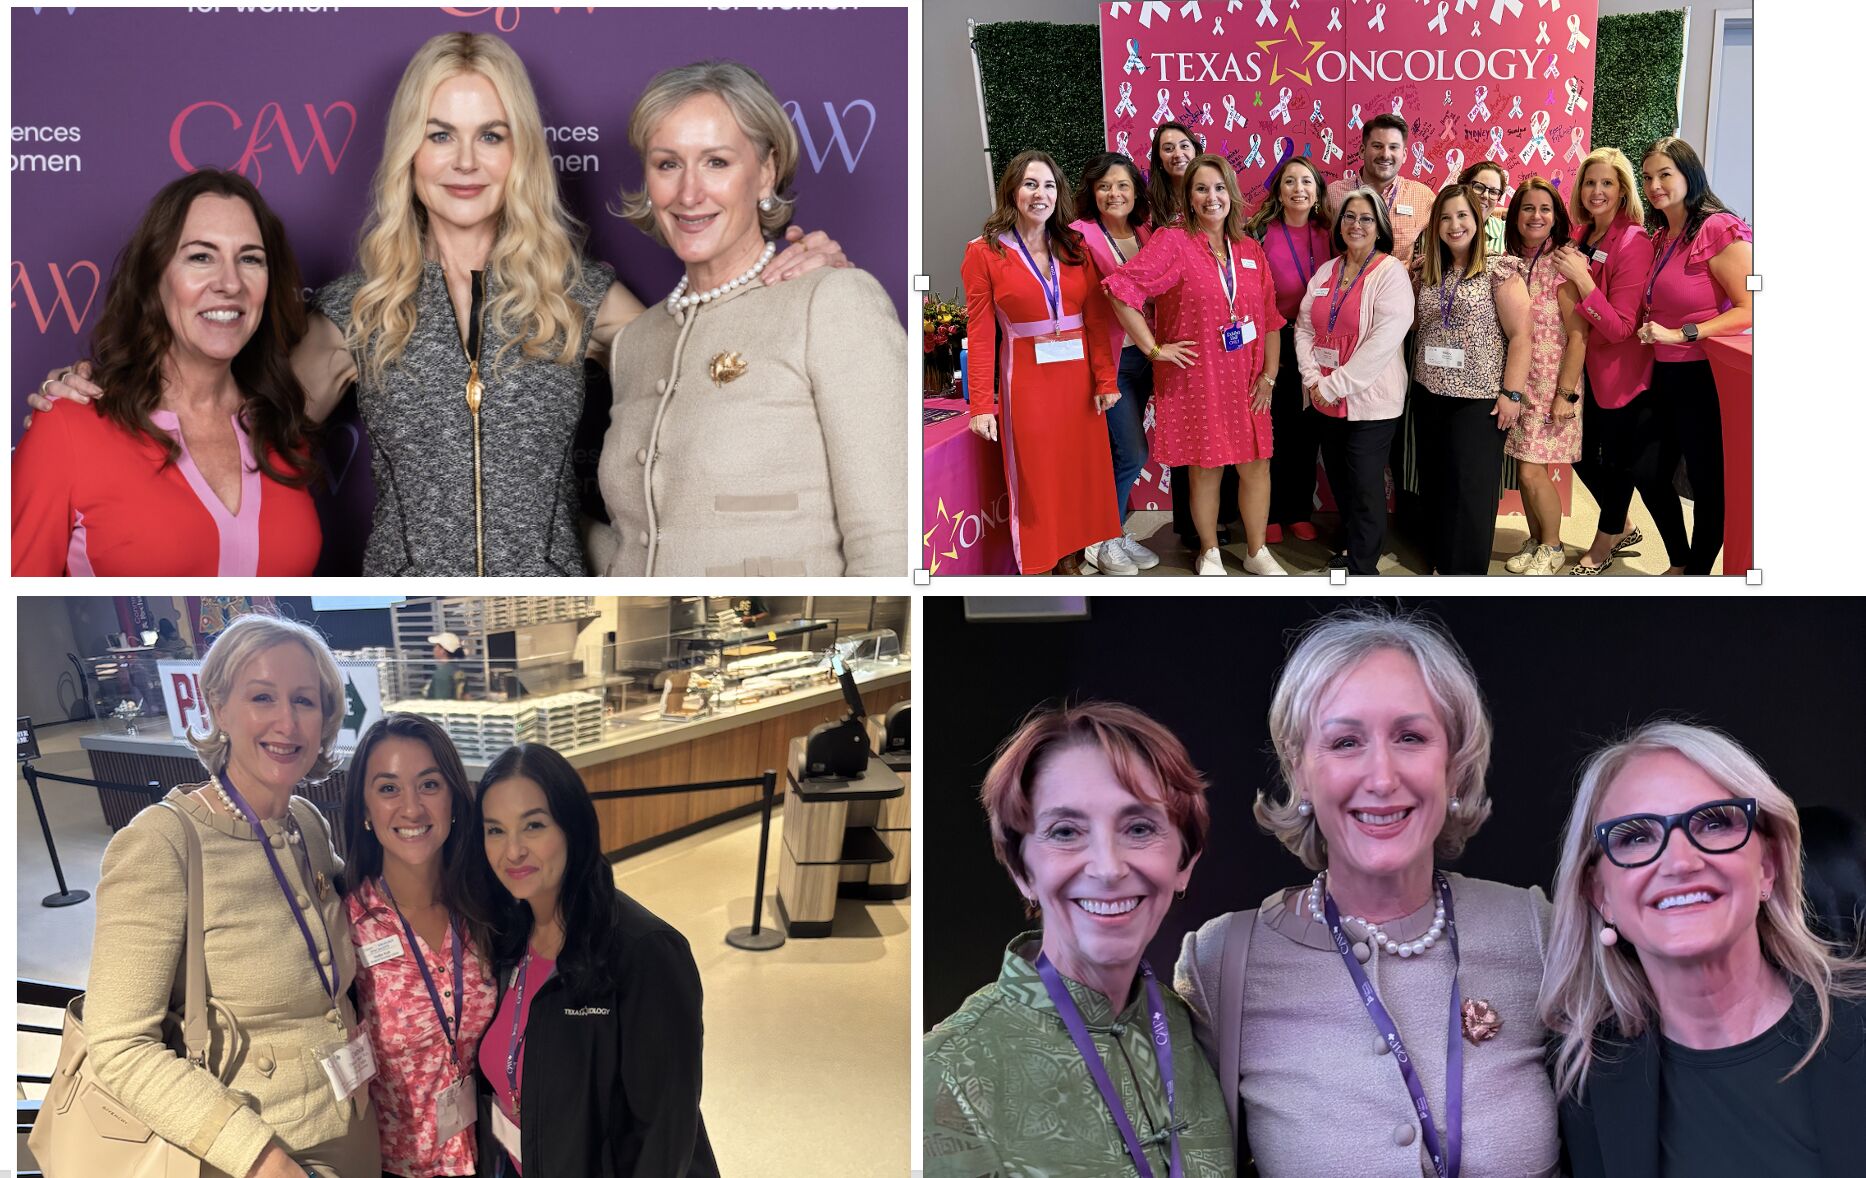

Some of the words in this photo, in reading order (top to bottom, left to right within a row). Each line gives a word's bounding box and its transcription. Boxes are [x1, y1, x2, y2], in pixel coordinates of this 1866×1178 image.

[1150, 52, 1262, 82] TEXAS
[1316, 48, 1547, 83] ONCOLOGY
[11, 126, 81, 142] ences
[543, 126, 600, 142] nces
